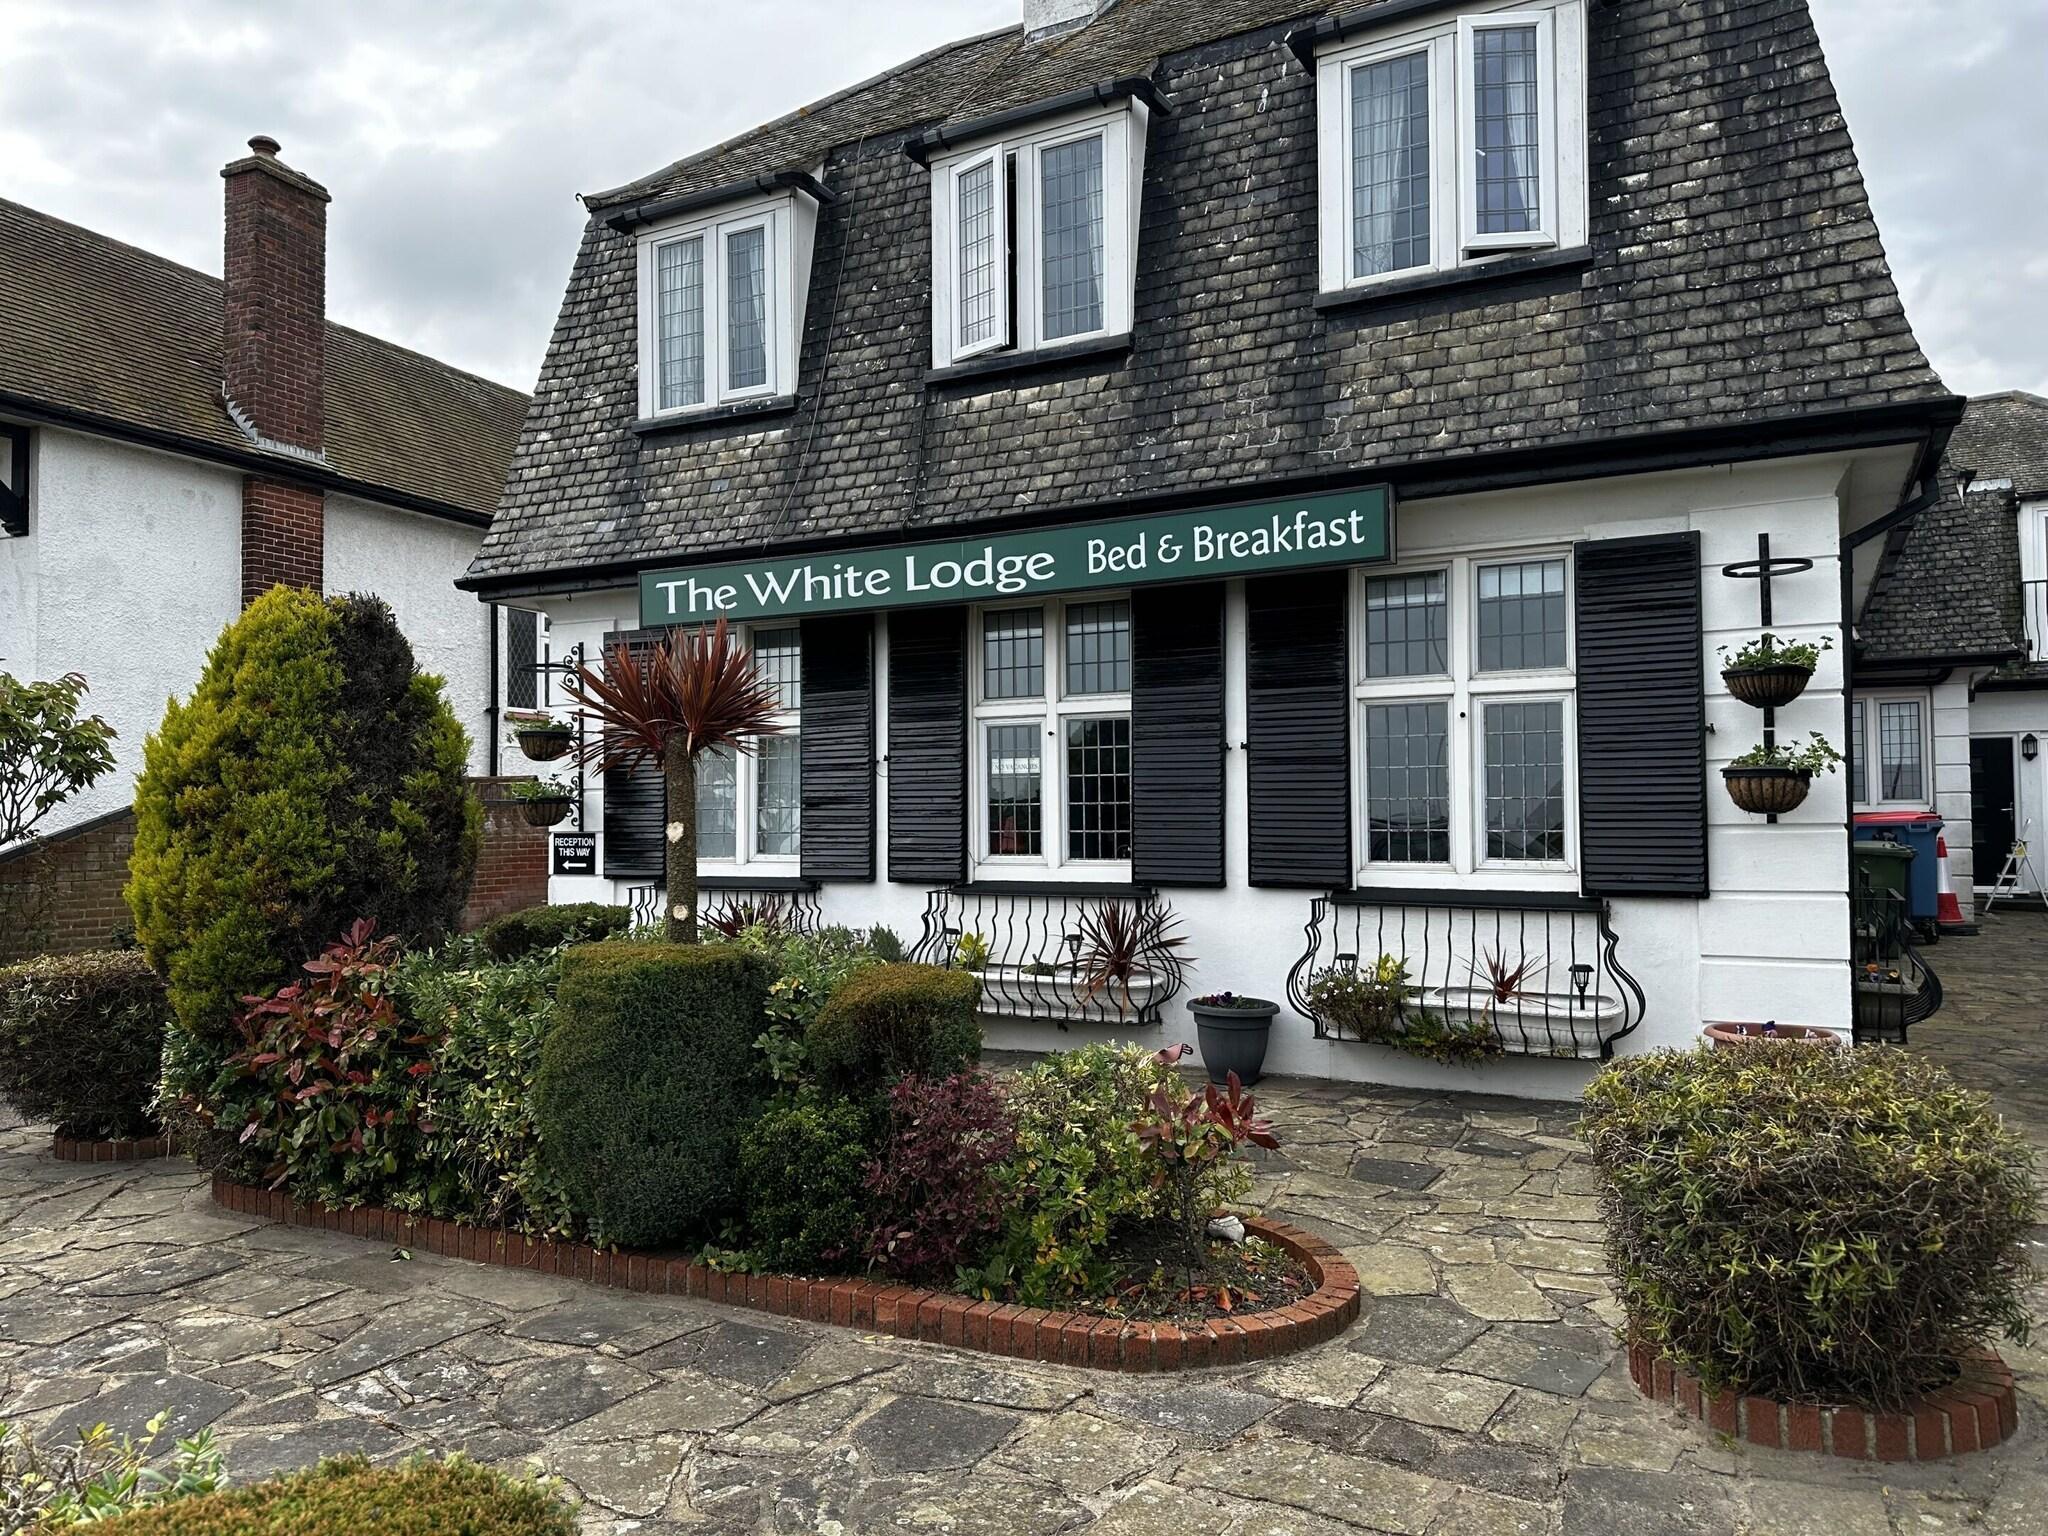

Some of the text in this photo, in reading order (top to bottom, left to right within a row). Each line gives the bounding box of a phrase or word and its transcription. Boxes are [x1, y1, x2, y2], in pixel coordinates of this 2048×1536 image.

[655, 509, 1365, 614] The White Lodge Bed & Breakfast
[554, 837, 594, 846] RECEPTION
[558, 847, 591, 857] THIS WAY
